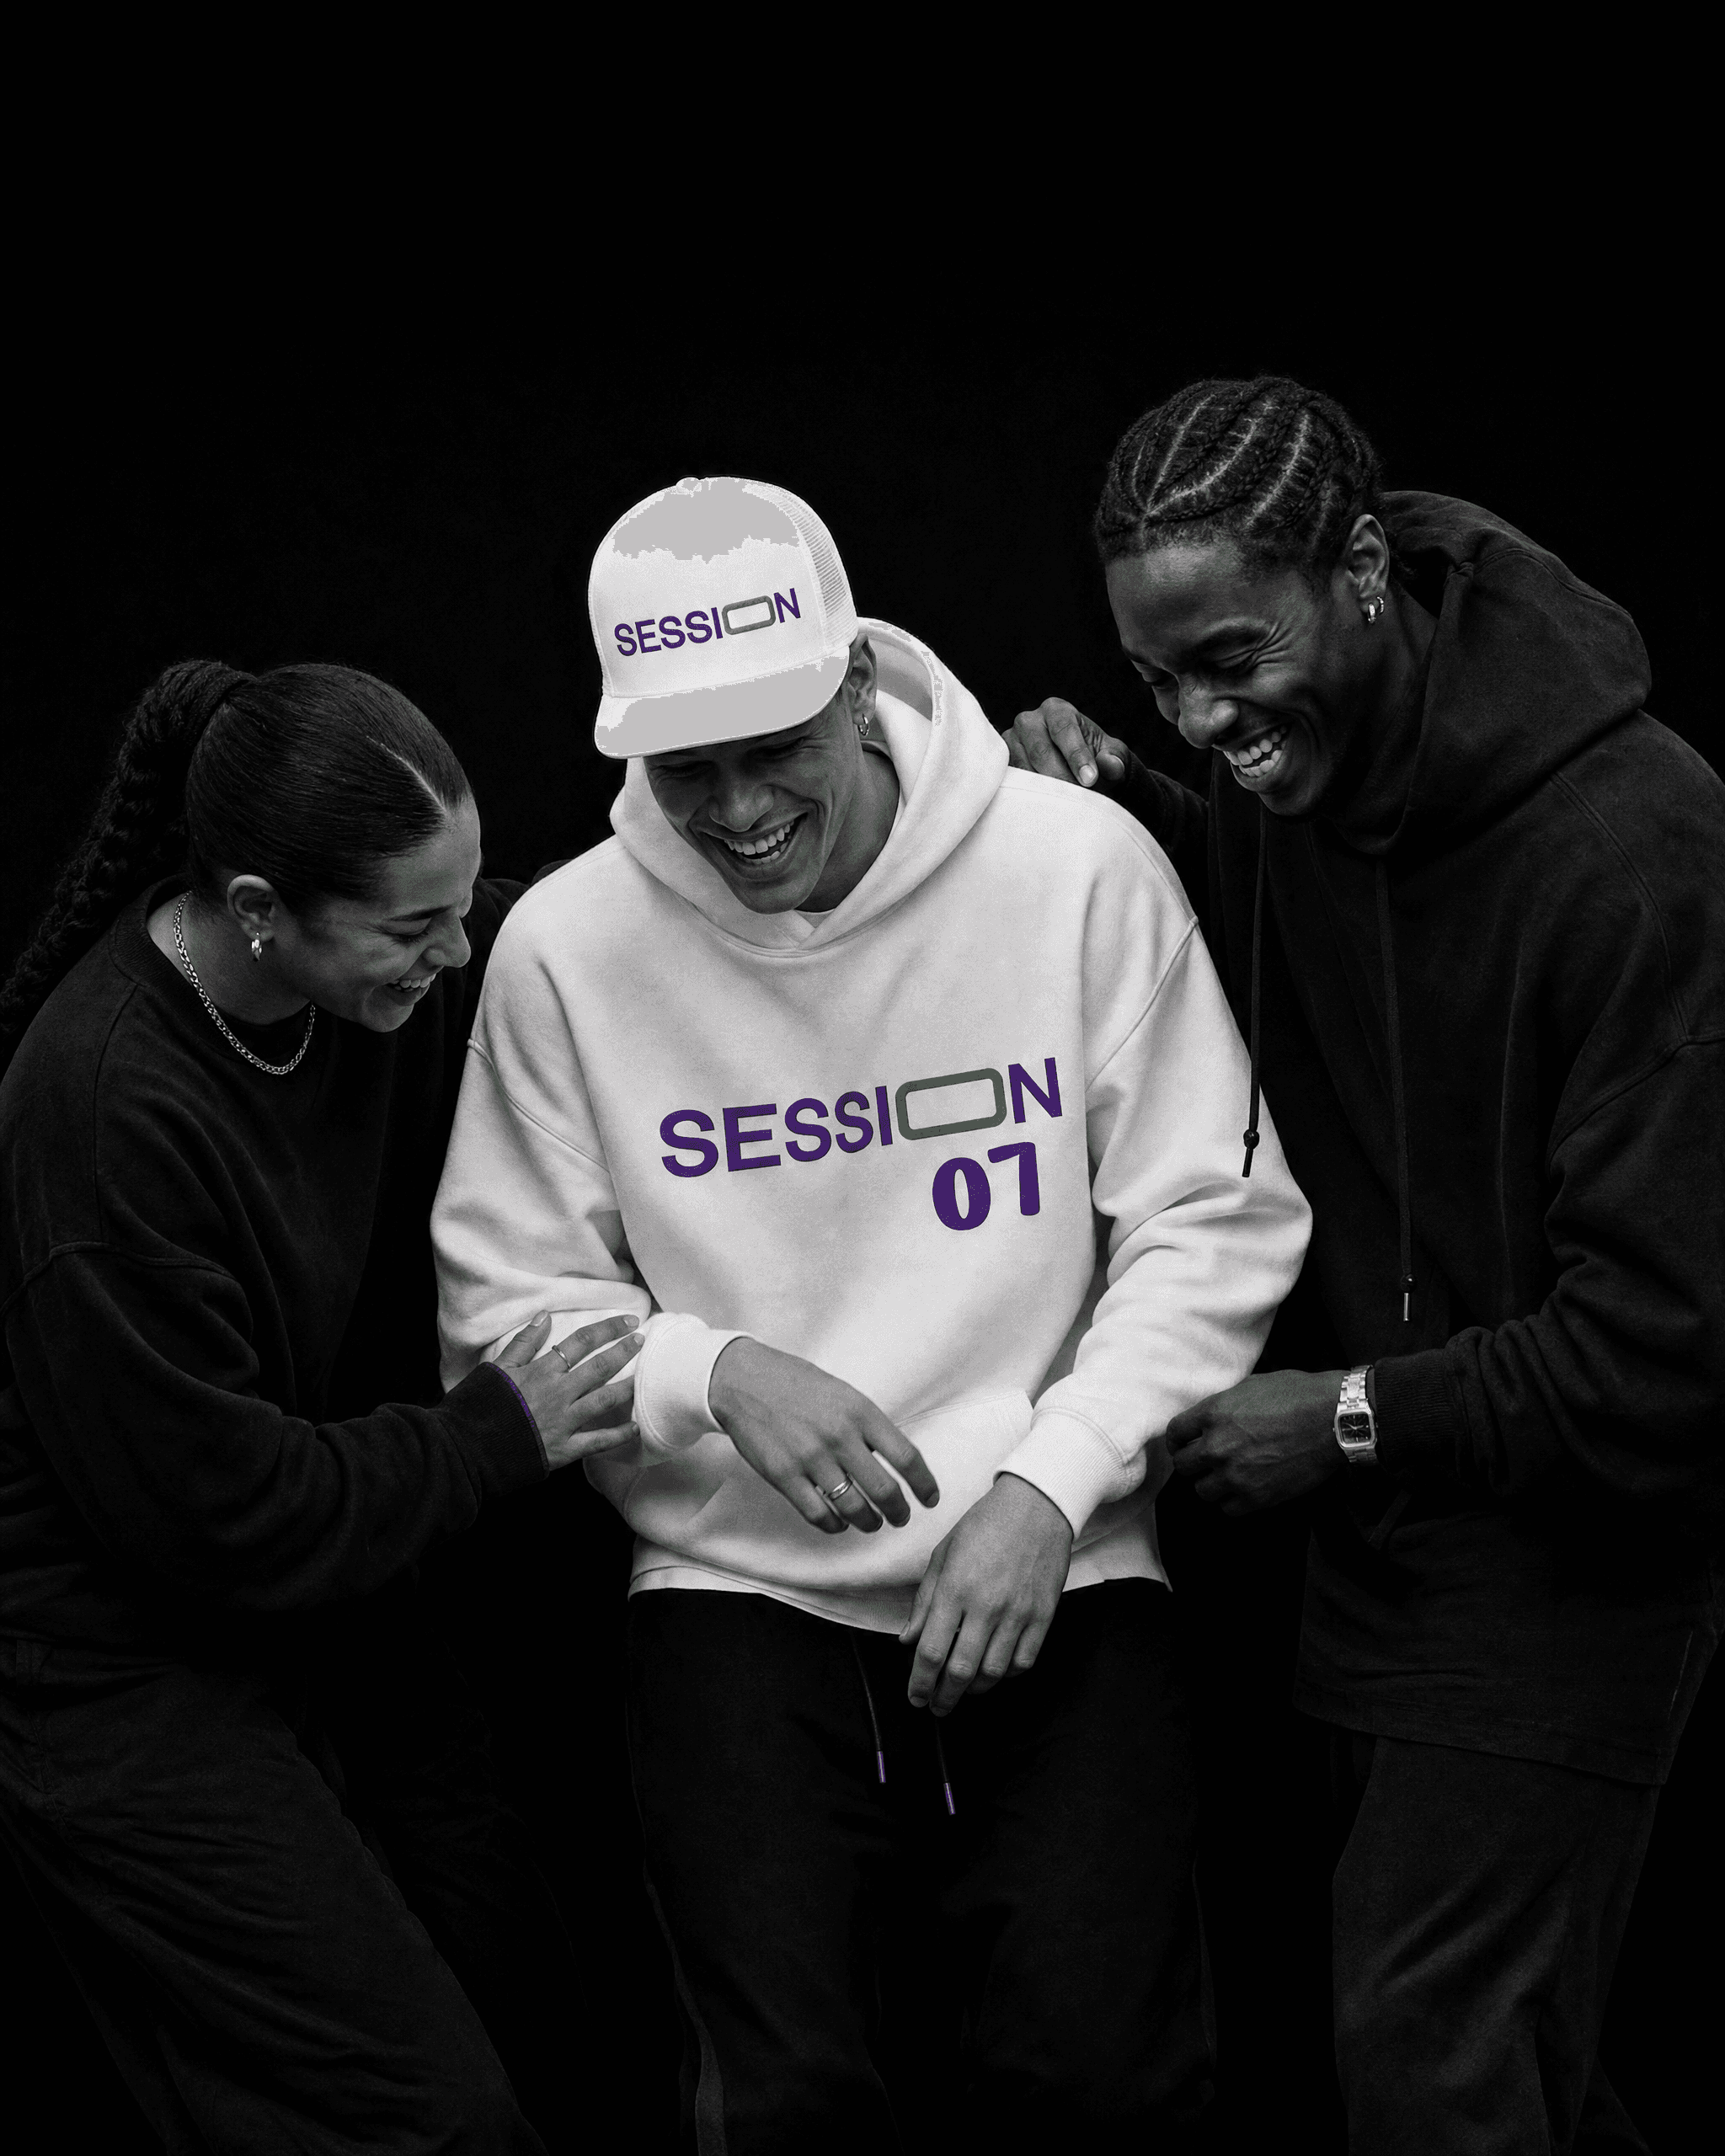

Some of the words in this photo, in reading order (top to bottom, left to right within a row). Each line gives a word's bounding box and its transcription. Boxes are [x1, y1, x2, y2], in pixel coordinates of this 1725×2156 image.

[614, 588, 801, 656] SESSION
[660, 1057, 1063, 1177] SESSION
[932, 1142, 1040, 1231] 07
